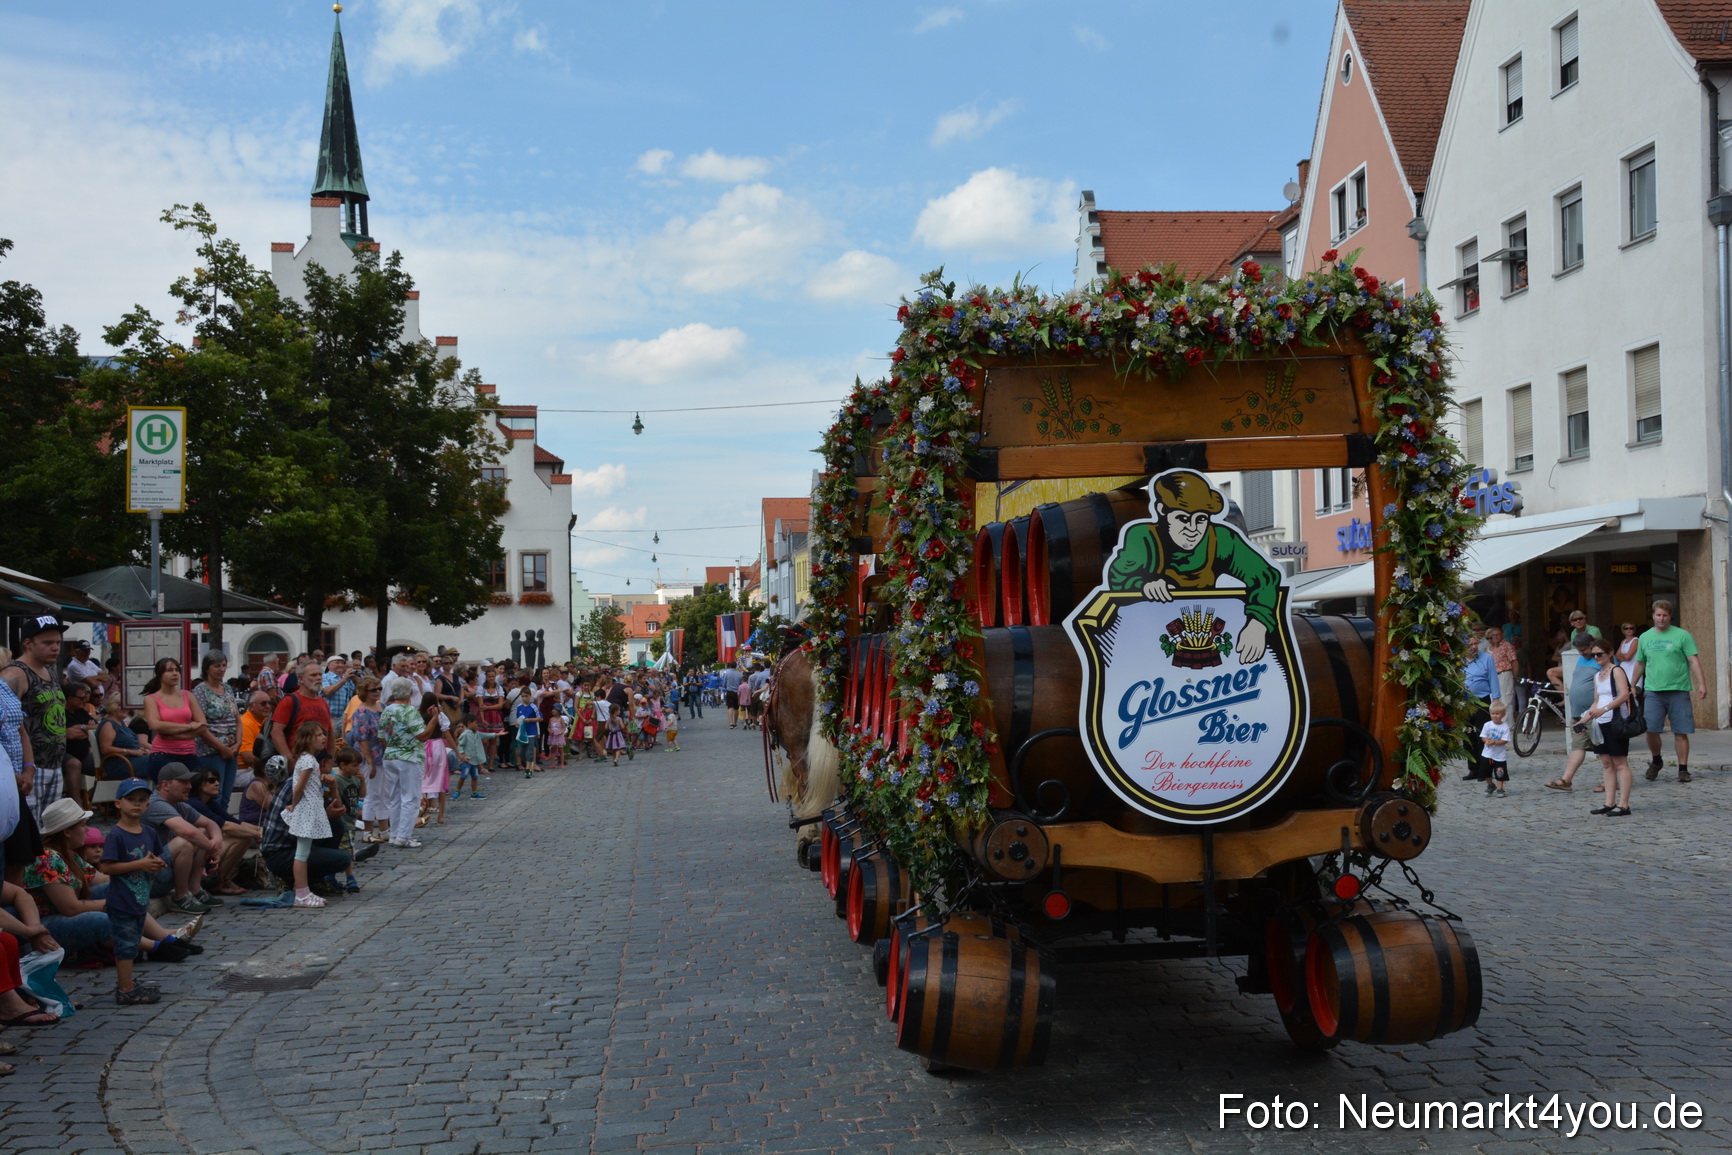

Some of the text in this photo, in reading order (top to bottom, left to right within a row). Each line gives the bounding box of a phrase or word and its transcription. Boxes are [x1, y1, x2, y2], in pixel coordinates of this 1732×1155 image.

[147, 424, 167, 446] H
[1271, 544, 1308, 556] sutor.
[1118, 663, 1268, 750] Glossner
[1197, 709, 1269, 745] Bier
[1141, 750, 1253, 776] Der hochfeine
[1151, 771, 1244, 798] Biergenuss
